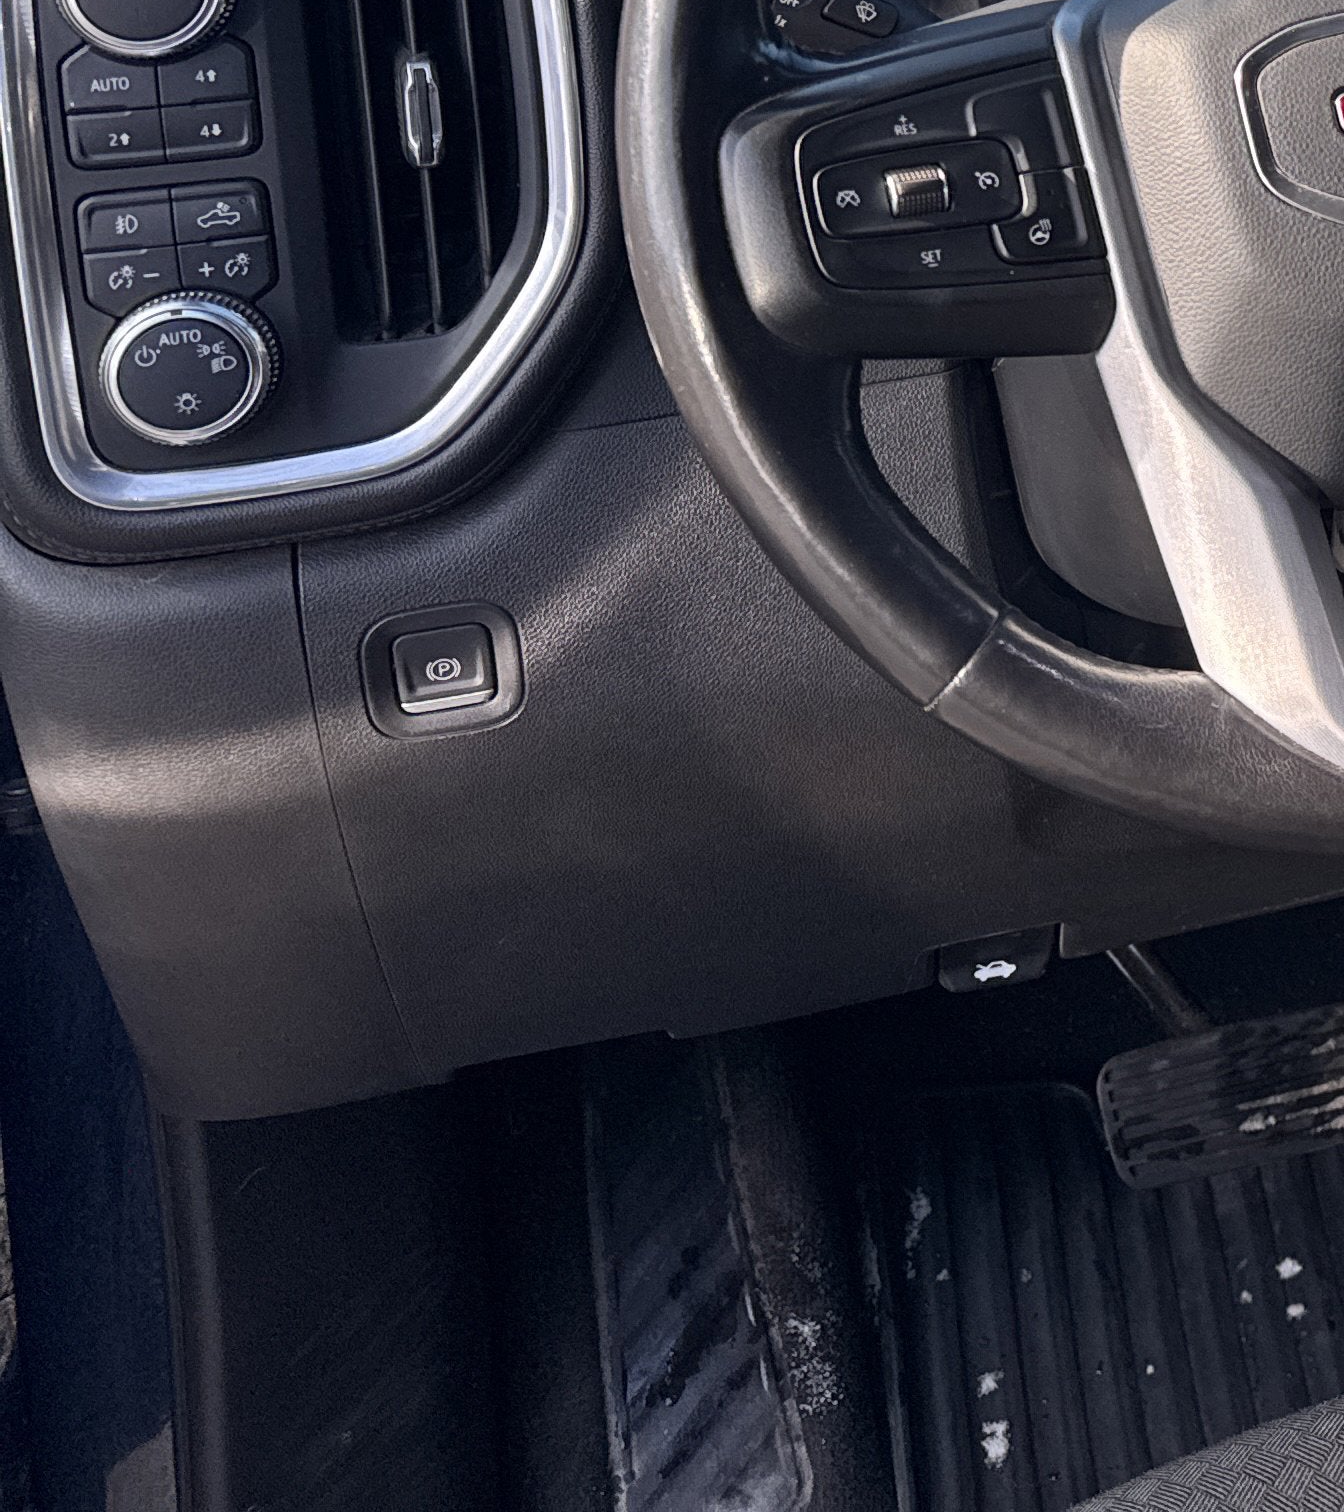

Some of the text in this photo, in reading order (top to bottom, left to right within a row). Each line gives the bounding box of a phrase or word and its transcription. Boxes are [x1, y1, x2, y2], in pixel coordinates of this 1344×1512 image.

[195, 69, 206, 82] 4
[90, 76, 130, 93] AUTO
[200, 124, 210, 138] 4
[894, 123, 918, 136] RES
[108, 133, 118, 147] 2
[920, 248, 942, 265] SET
[159, 328, 202, 347] AUTO
